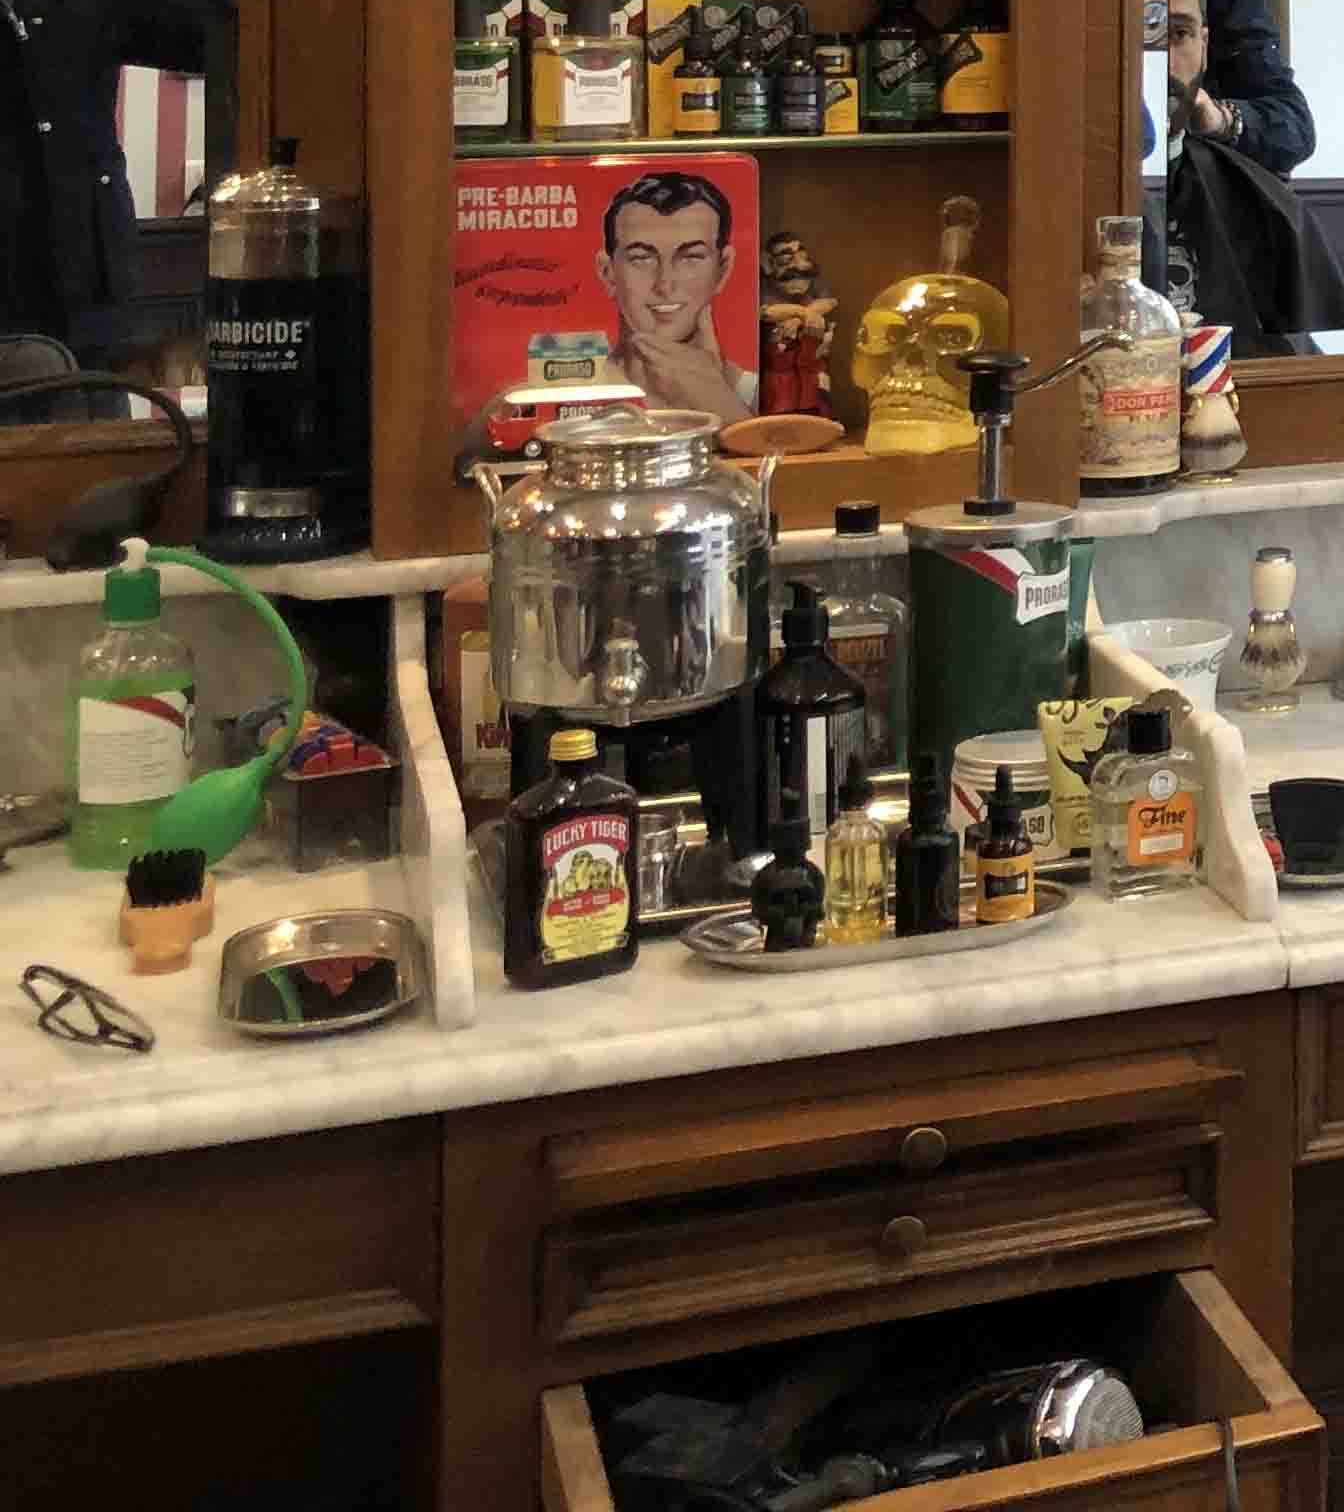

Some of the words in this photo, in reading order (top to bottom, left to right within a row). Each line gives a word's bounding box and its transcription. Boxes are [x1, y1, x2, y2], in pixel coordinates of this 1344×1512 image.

[456, 184, 578, 208] PRE-BARBA
[456, 207, 579, 232] MIRACOLO
[546, 822, 588, 856] LUCKY
[590, 821, 628, 841] TIGER
